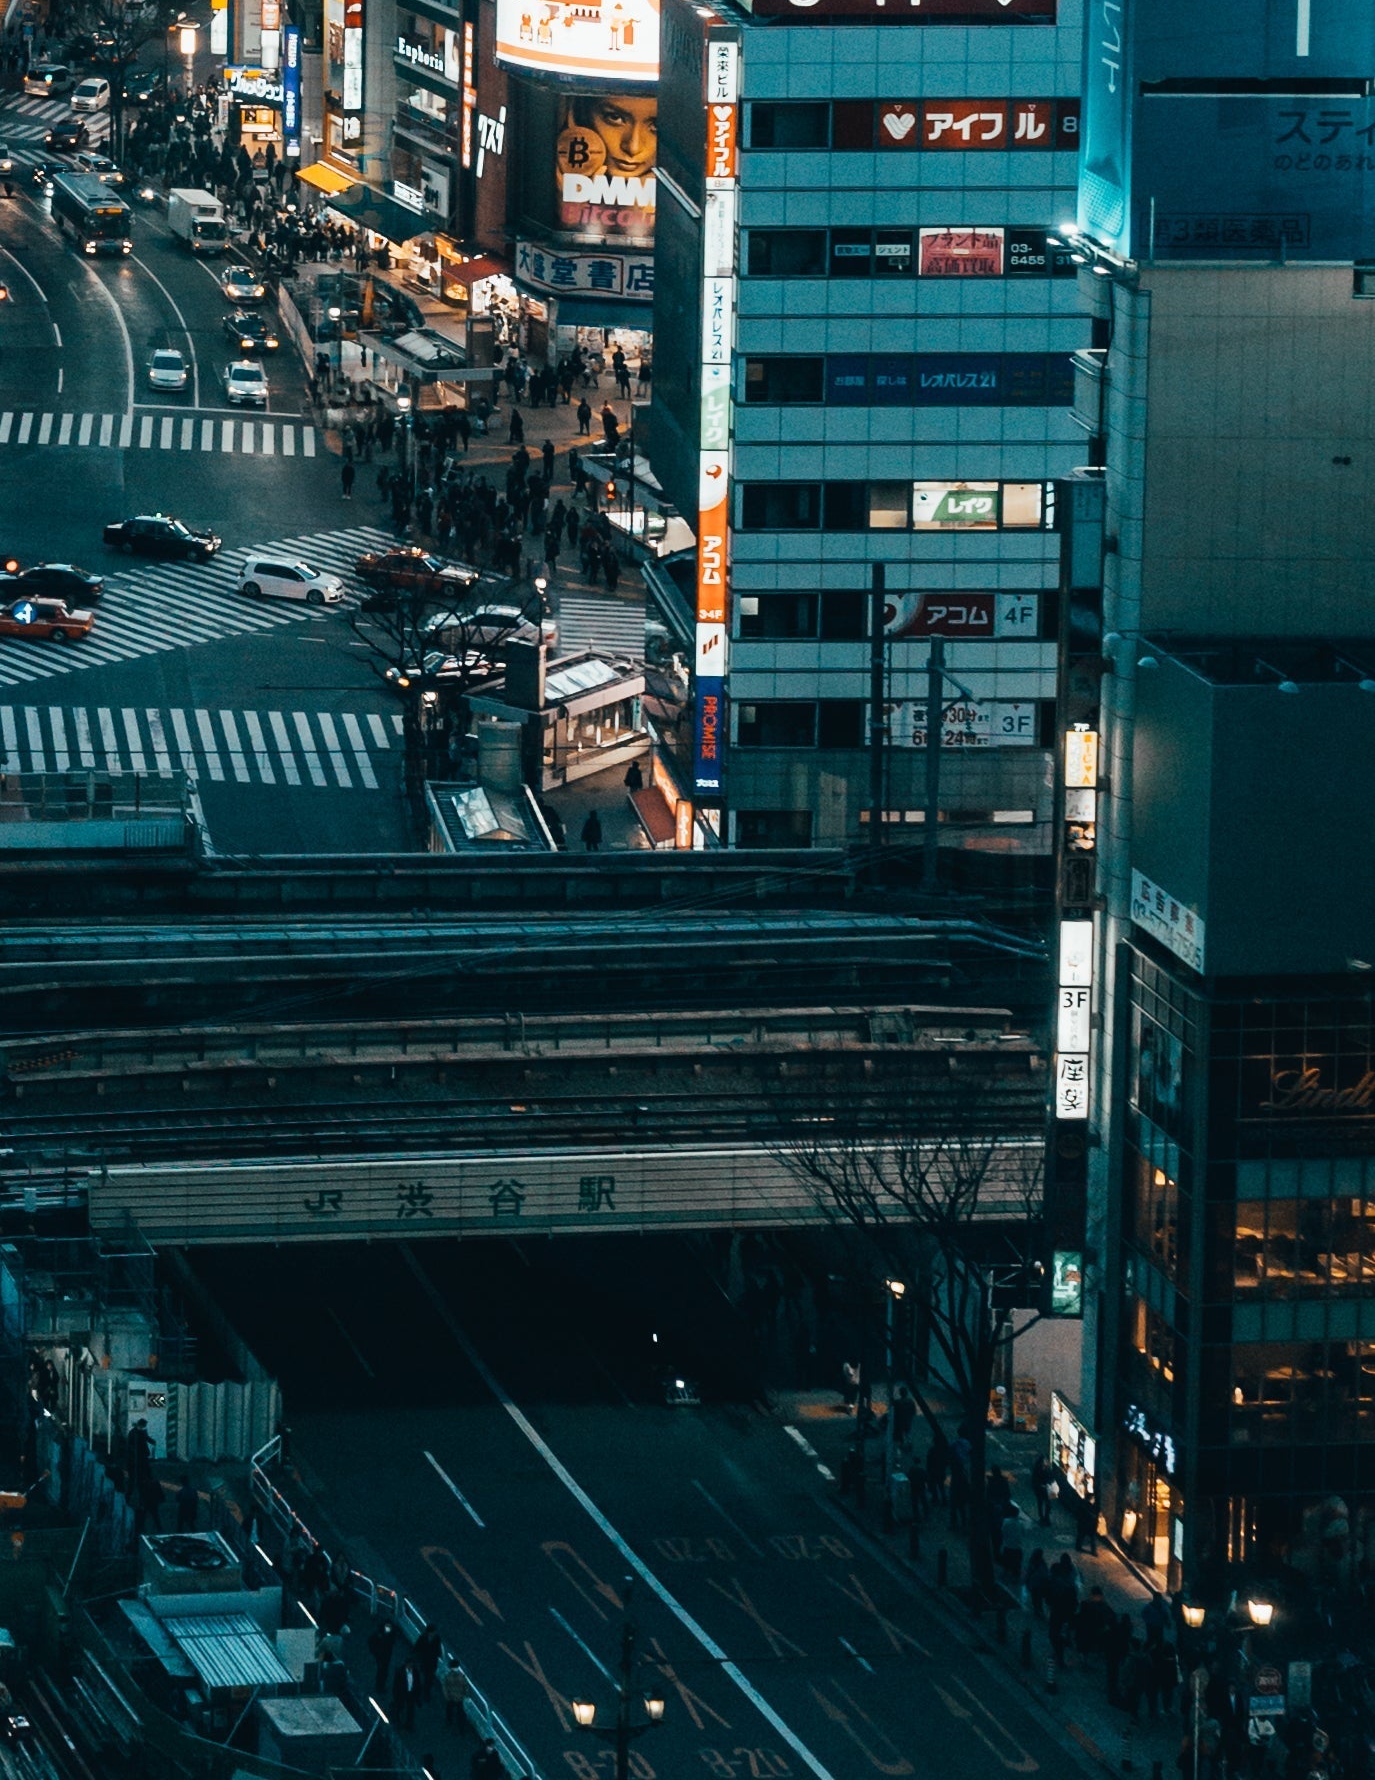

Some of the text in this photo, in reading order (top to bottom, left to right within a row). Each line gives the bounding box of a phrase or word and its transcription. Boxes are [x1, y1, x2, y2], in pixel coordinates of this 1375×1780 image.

[397, 36, 445, 72] Euphoria
[925, 111, 1046, 141] アイフル
[712, 120, 732, 178] アイフル
[562, 173, 656, 207] DMM
[1010, 255, 1046, 266] 6455
[711, 281, 724, 347] レオパレス
[947, 496, 994, 516] レイク
[701, 534, 723, 586] アコム
[926, 605, 1033, 626] アコム 4F
[701, 694, 717, 761] PROMISE
[1001, 714, 1030, 733] 3F
[1063, 991, 1088, 1009] 3F
[396, 1175, 617, 1218] 渋谷駅
